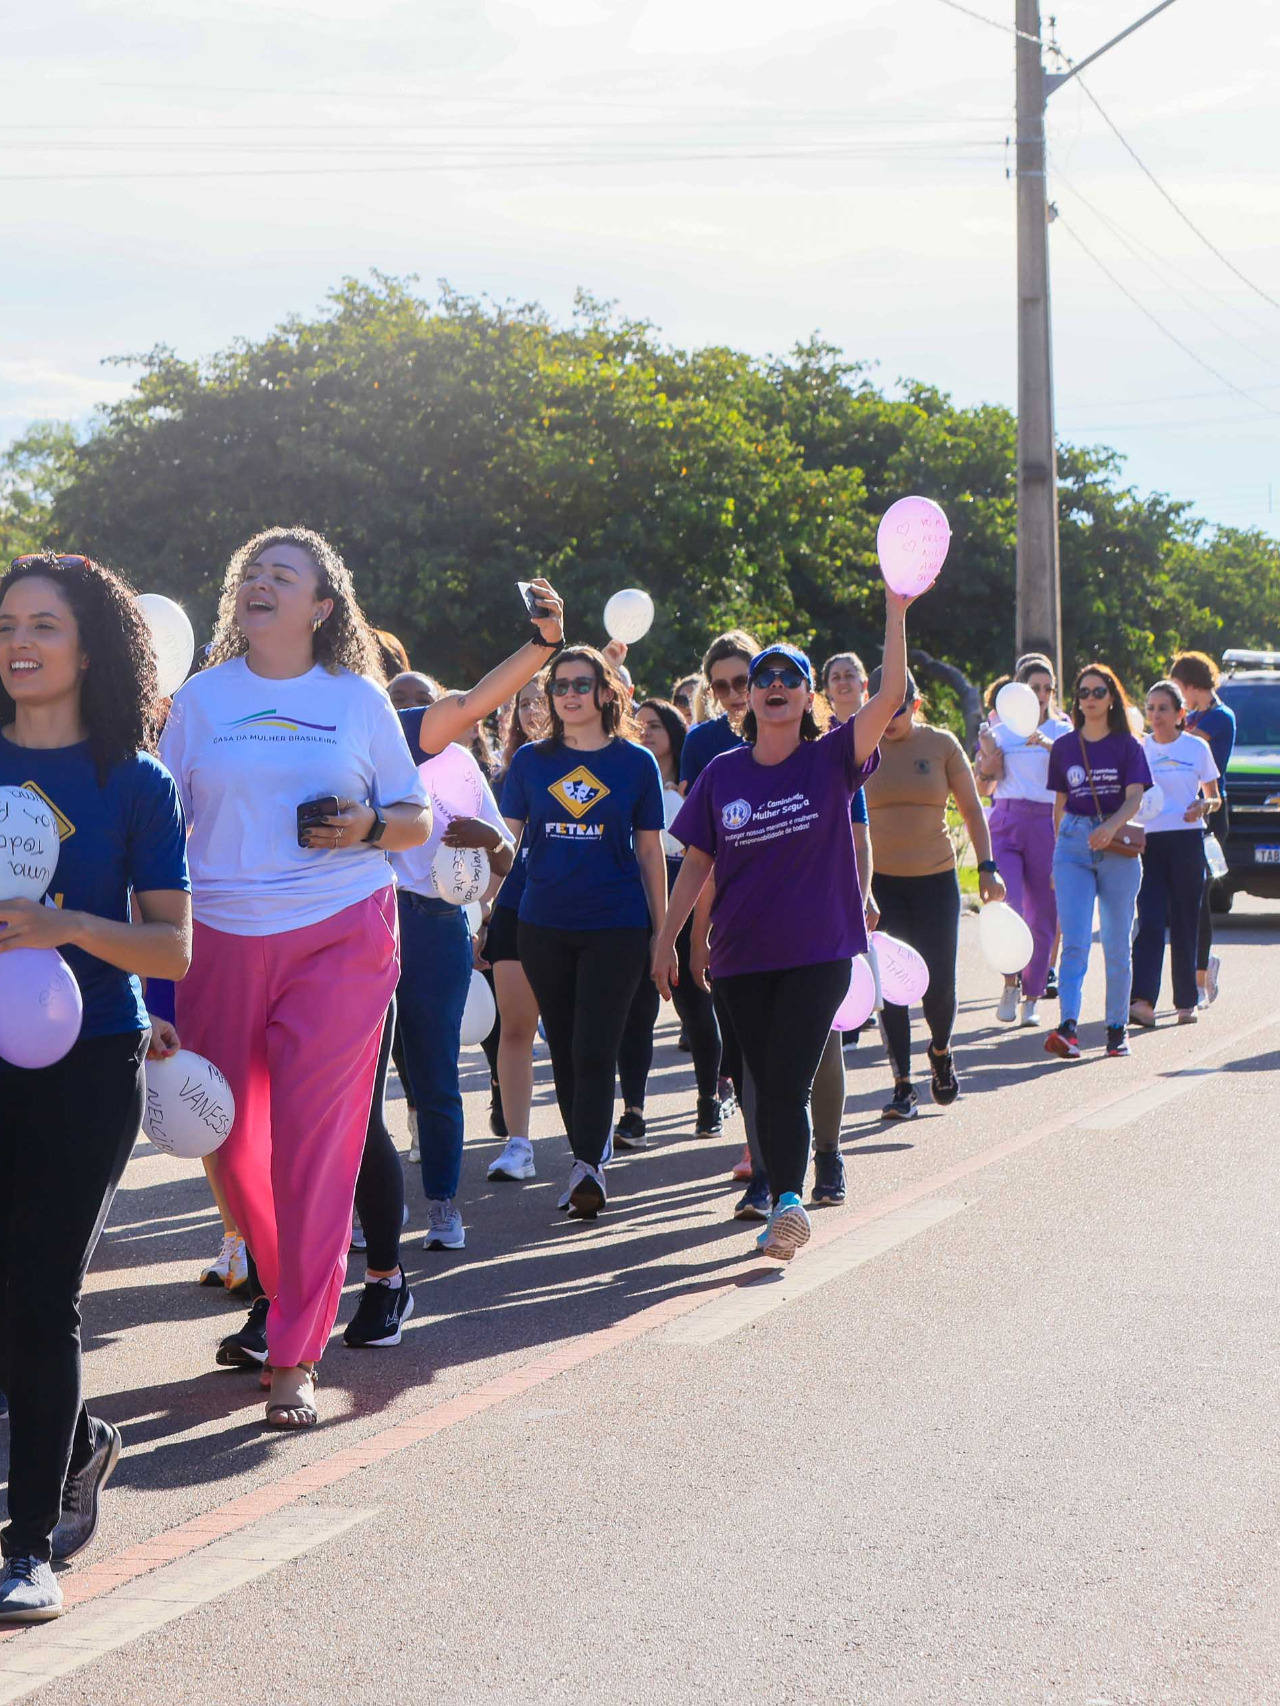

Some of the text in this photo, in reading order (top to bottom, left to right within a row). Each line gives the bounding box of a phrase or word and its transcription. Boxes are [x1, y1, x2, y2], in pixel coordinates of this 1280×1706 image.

[213, 736, 234, 744] CASA
[250, 734, 286, 742] MULHER
[288, 735, 337, 745] BRASILEIRA
[752, 808, 780, 821] Mulher
[545, 822, 604, 835] FETRAN
